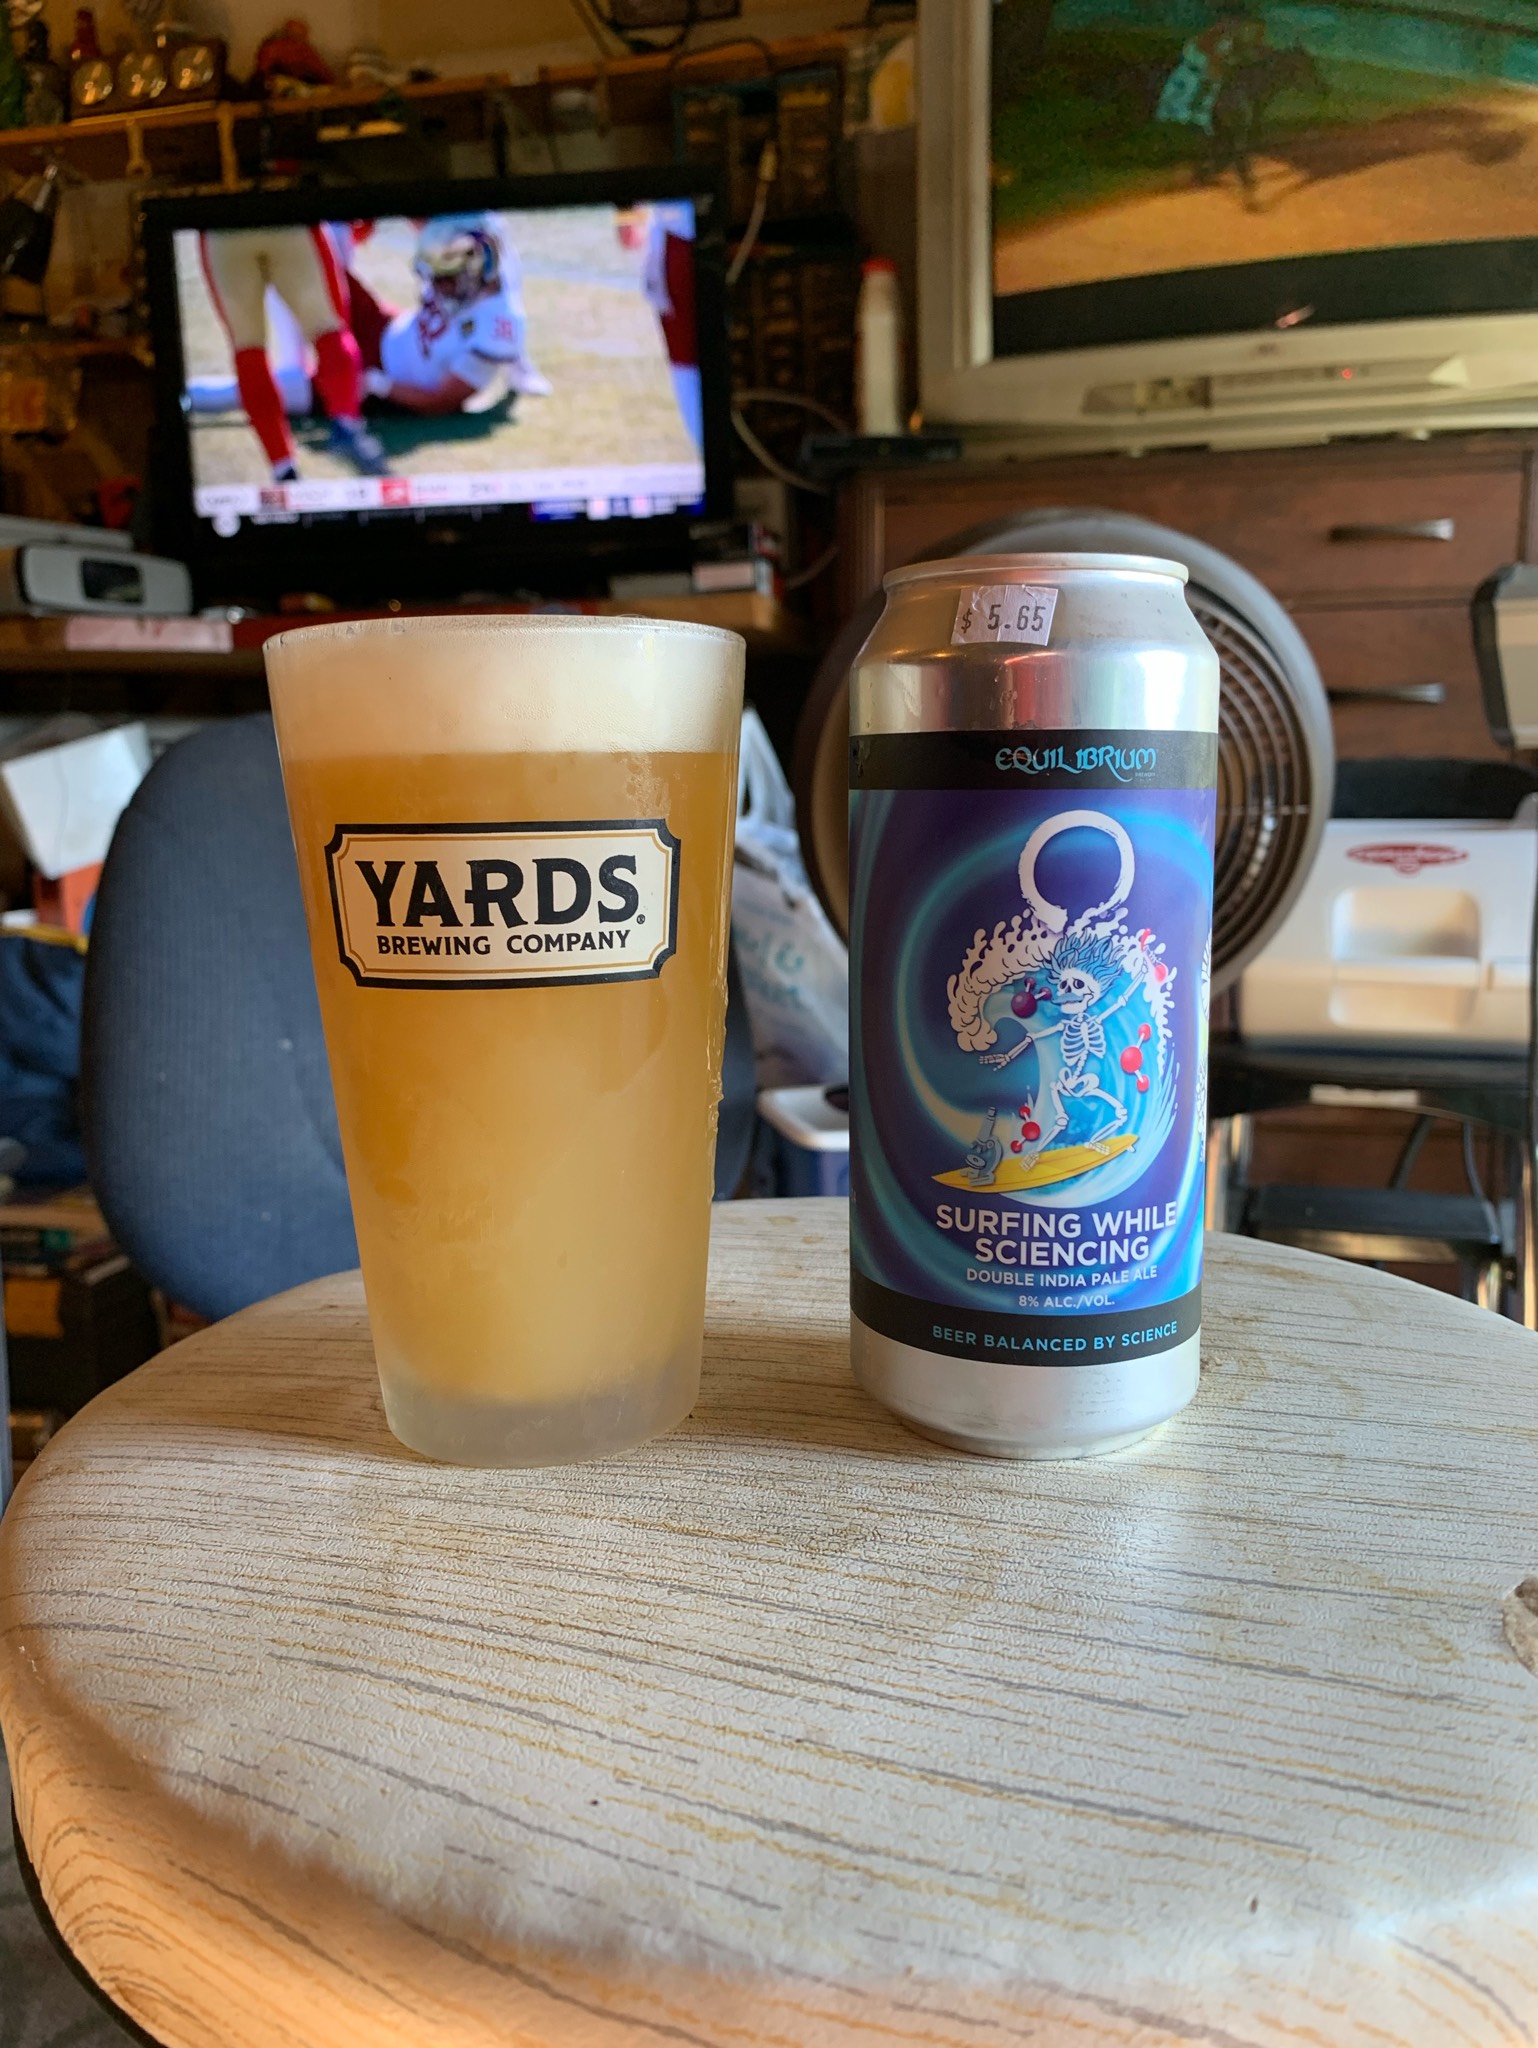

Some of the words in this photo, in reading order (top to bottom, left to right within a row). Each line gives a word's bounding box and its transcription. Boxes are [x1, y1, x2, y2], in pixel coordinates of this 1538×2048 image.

[960, 610, 973, 634] $
[987, 603, 1047, 632] 5.65
[995, 744, 1157, 782] EQUILIBRIUM
[377, 934, 491, 956] BREWING
[506, 929, 631, 954] COMPANY
[935, 1204, 1082, 1239] SURFING
[1091, 1200, 1178, 1237] WHILE
[974, 1235, 1150, 1267] SCIENCING
[966, 1267, 1034, 1287] DOUBLE
[1039, 1269, 1087, 1287] INDIA
[1091, 1267, 1129, 1286] PALE
[1131, 1265, 1158, 1281] ALE
[1018, 1295, 1039, 1307] 8%
[1043, 1295, 1116, 1309] ALC./VOL.
[932, 1325, 977, 1346] BEER
[984, 1335, 1087, 1352] BALANCED
[1093, 1336, 1115, 1350] BY
[1121, 1320, 1178, 1347] SCIENCE
